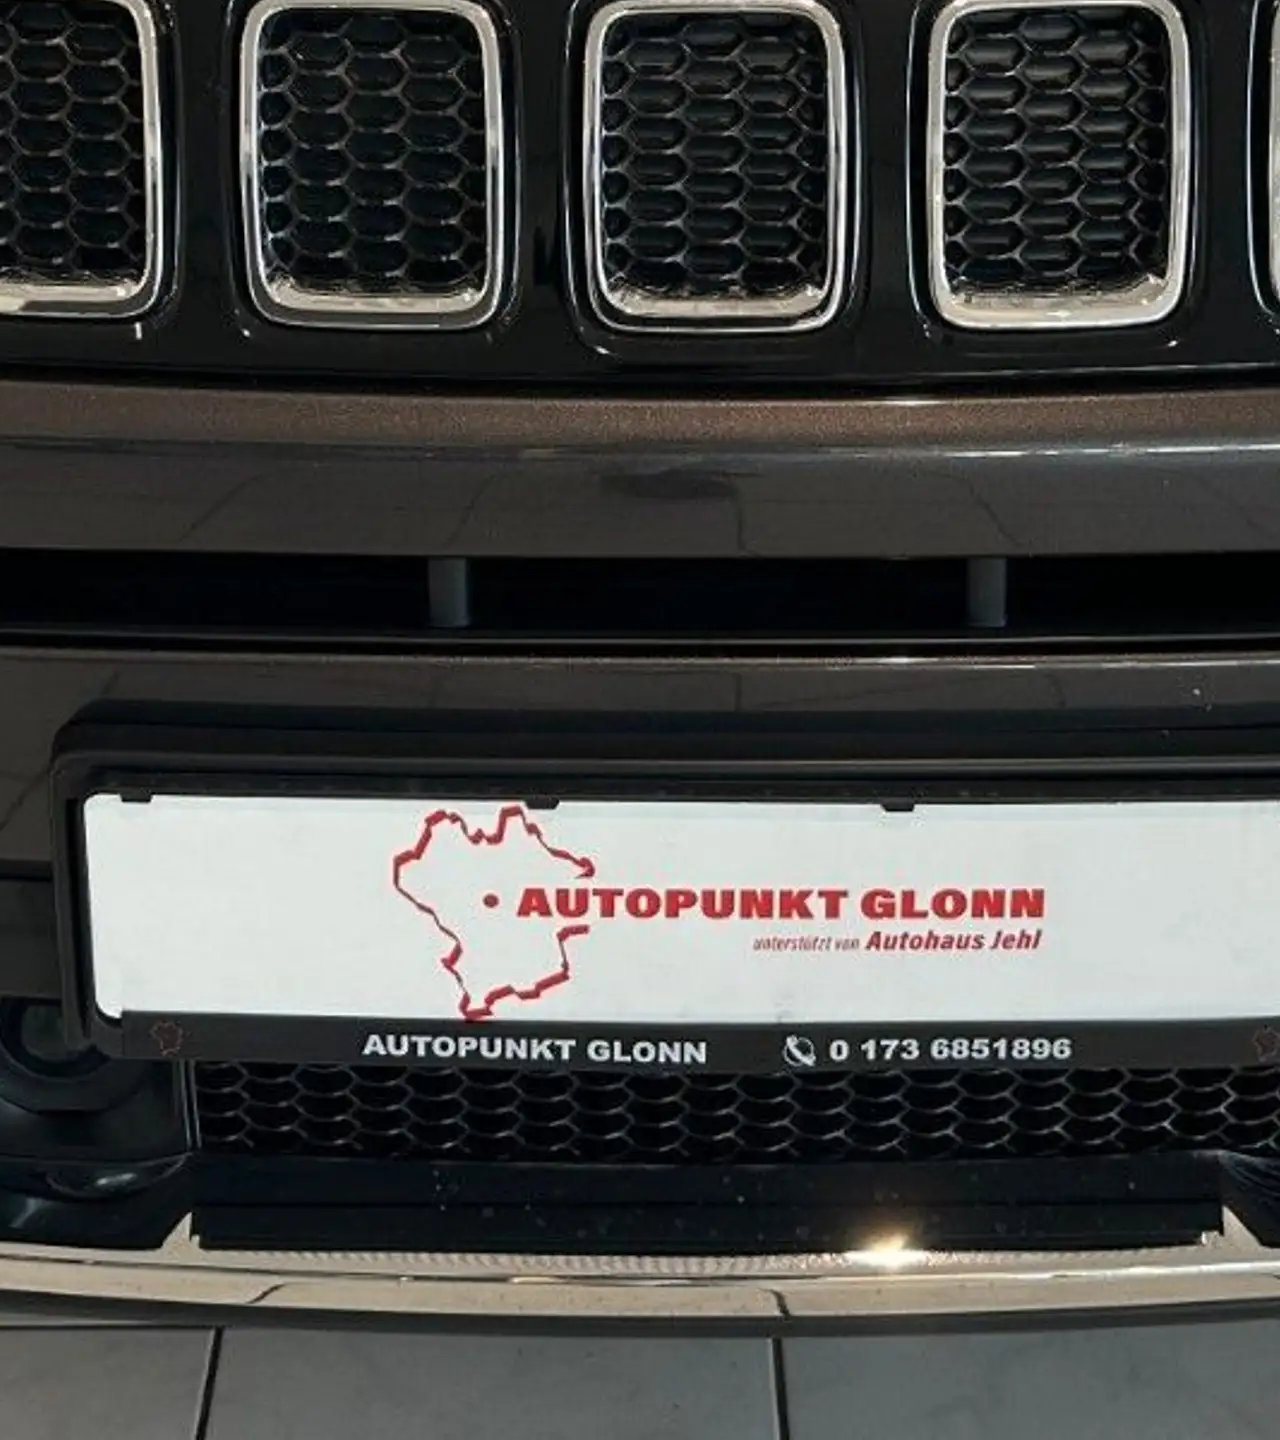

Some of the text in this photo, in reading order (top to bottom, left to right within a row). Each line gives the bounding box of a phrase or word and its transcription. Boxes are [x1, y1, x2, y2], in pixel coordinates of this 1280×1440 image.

[515, 886, 1046, 921] AUTOPUNKT GLONN
[834, 938, 861, 952] von
[864, 929, 985, 952] Autohaus
[990, 928, 1043, 951] Jehl
[361, 1033, 1072, 1065] AUTOPUNKT GLONN 0 173 6851896
